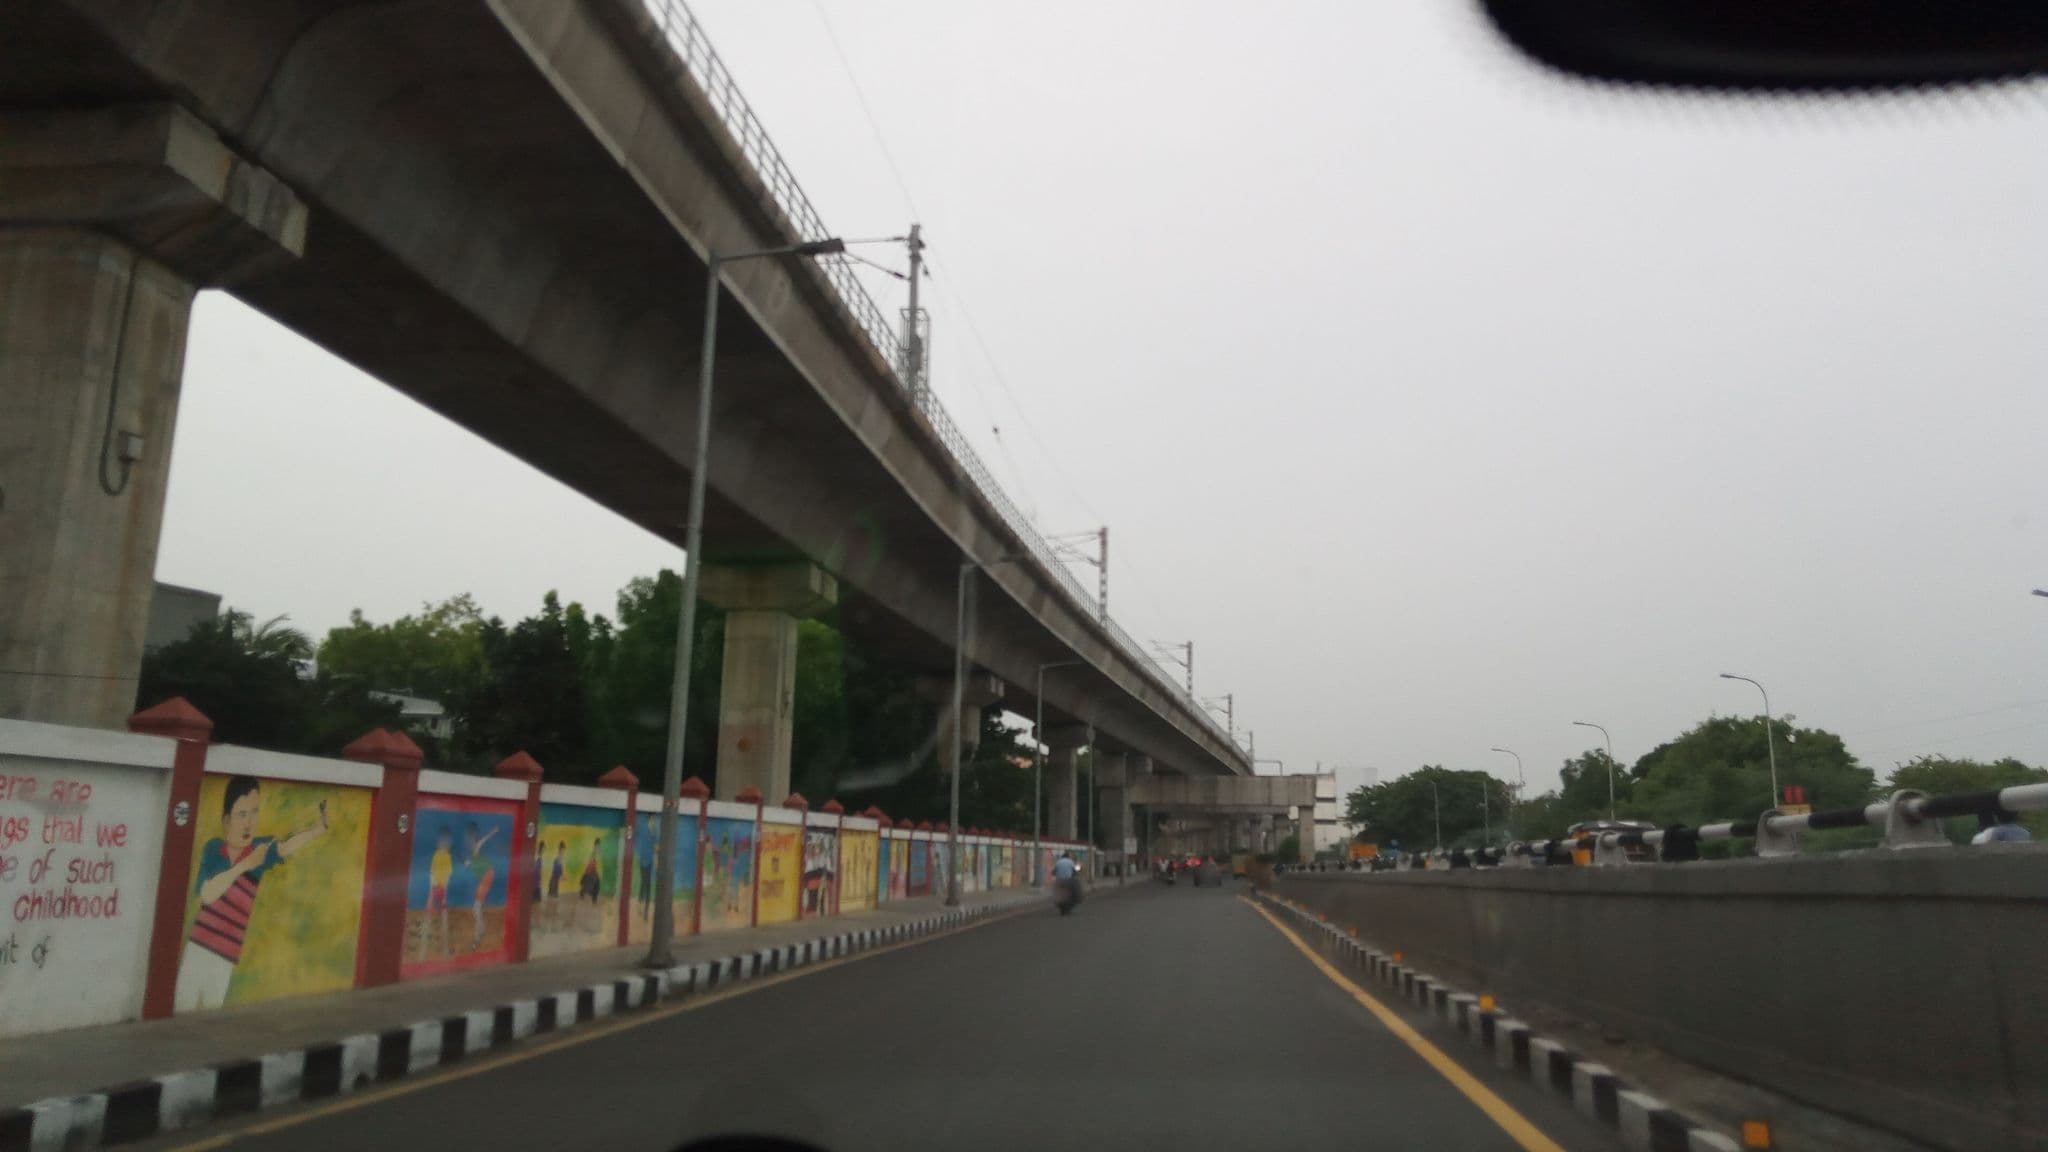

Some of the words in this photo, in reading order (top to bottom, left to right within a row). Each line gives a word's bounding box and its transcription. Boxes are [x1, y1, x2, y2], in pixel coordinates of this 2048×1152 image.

[51, 778, 92, 801] are
[42, 815, 83, 844] that
[96, 822, 128, 848] we
[29, 848, 56, 884] of
[67, 852, 115, 884] such
[31, 935, 51, 969] of
